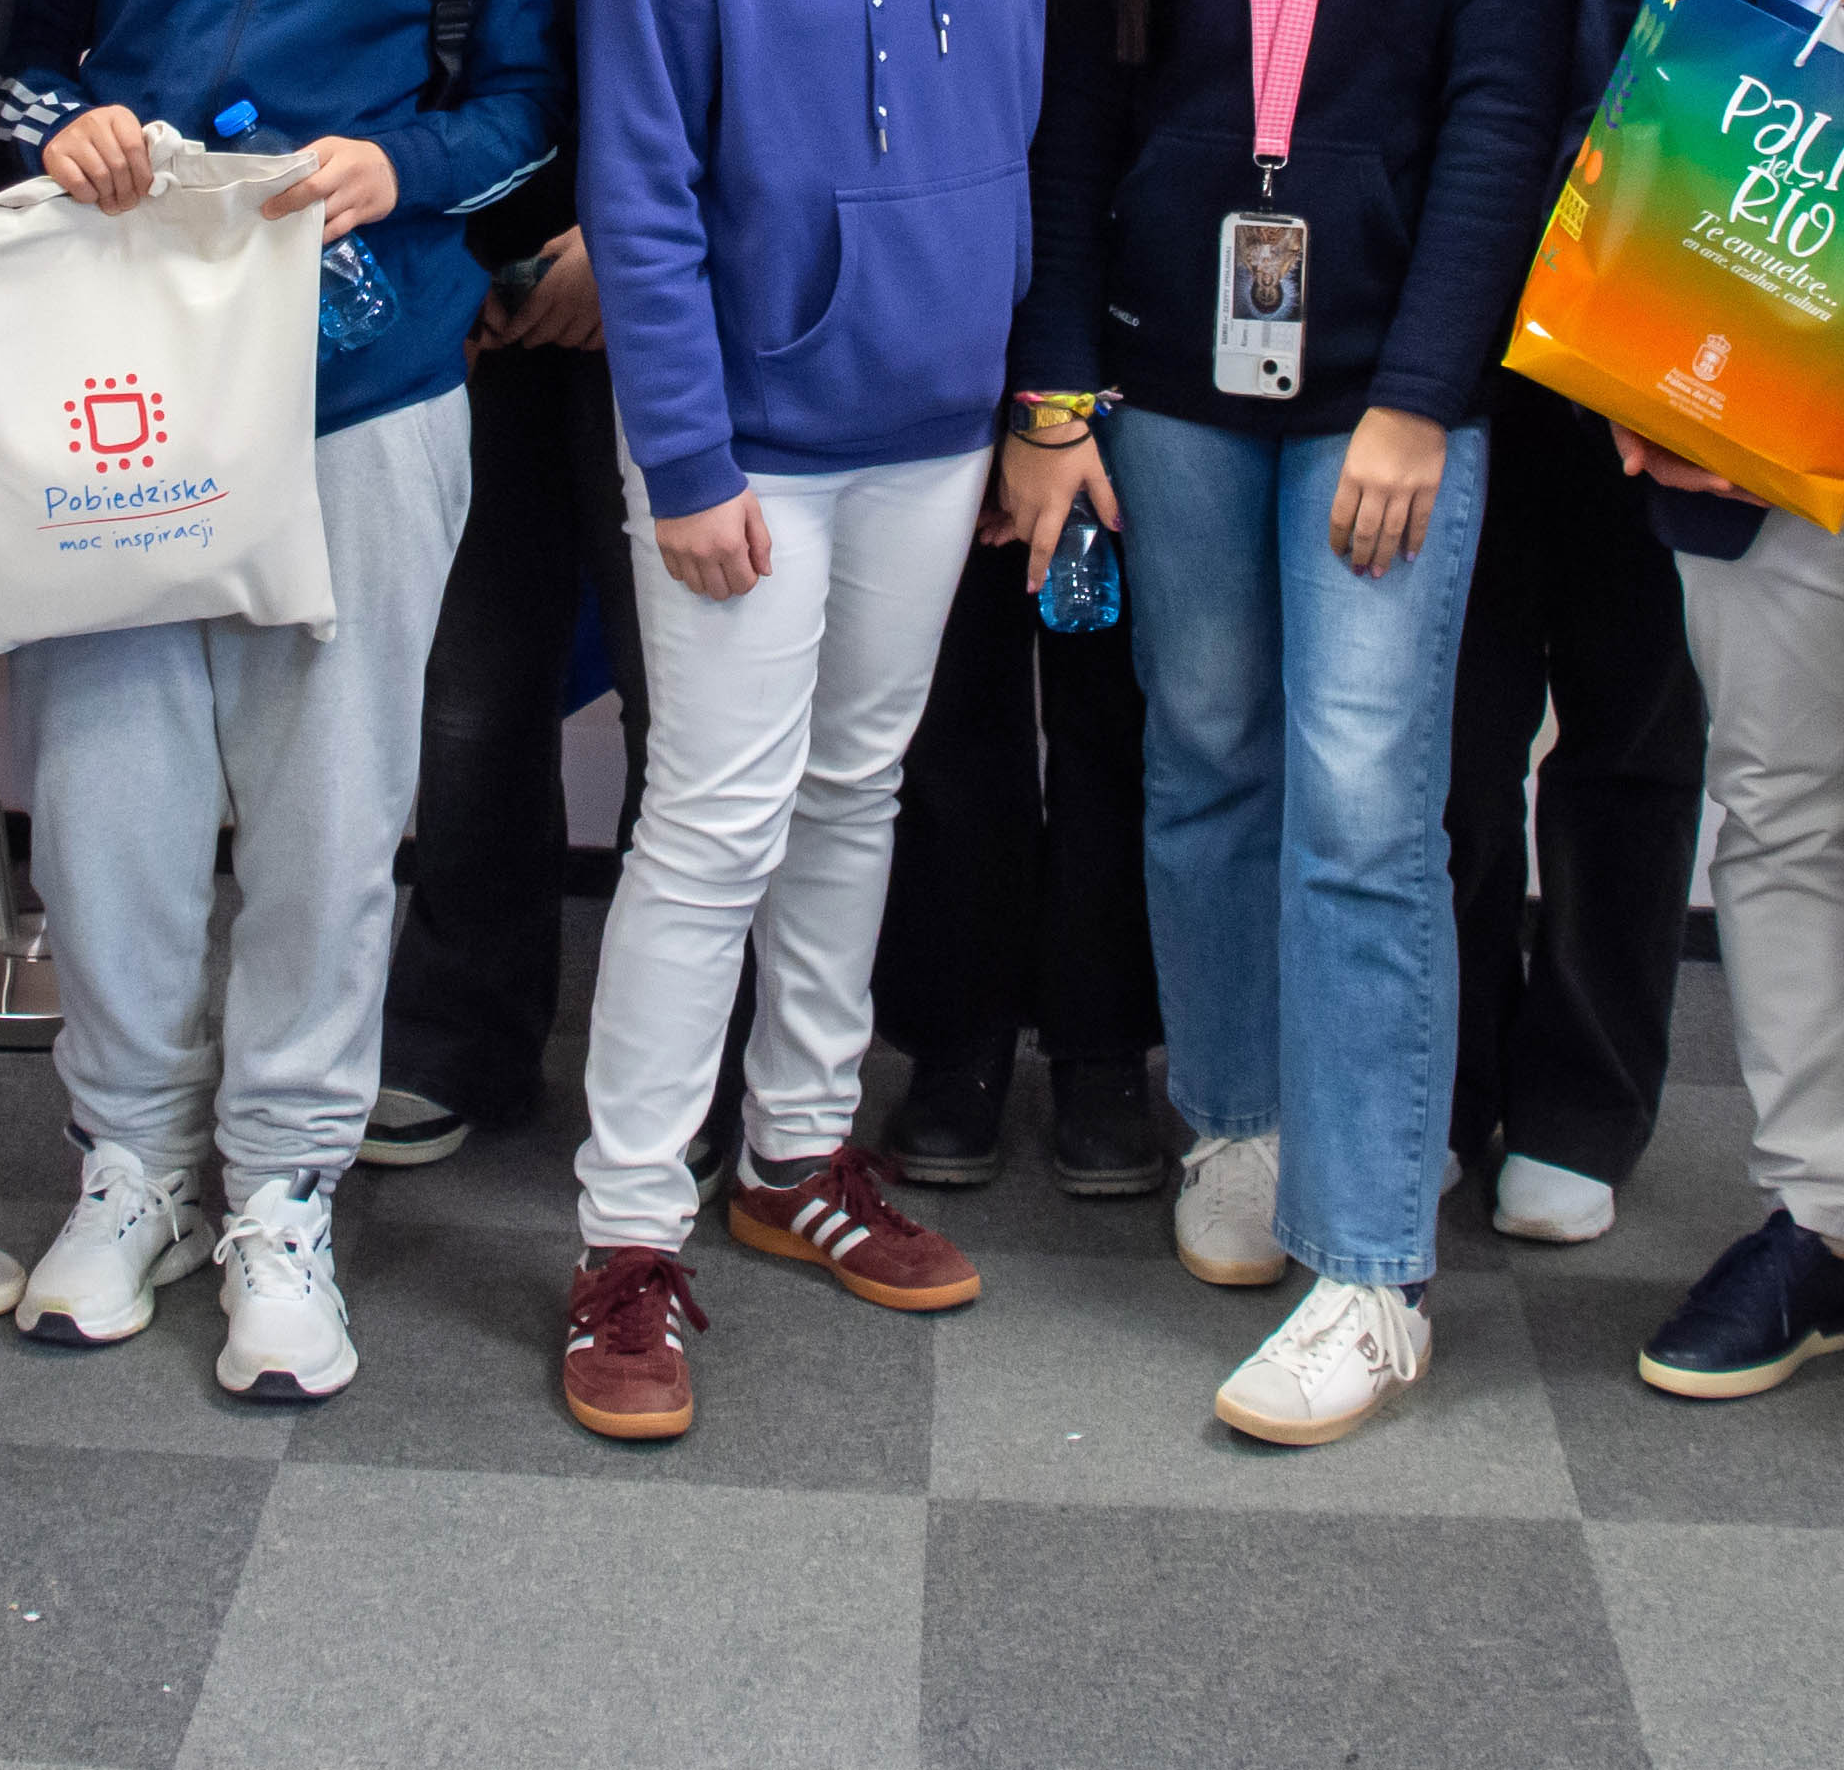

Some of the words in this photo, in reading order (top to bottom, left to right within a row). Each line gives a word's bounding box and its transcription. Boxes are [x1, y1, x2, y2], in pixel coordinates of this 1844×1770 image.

[1691, 209, 1725, 243] Te
[44, 476, 219, 520] Pobiedziska
[58, 534, 103, 552] moc
[111, 517, 215, 553] inspiracji
